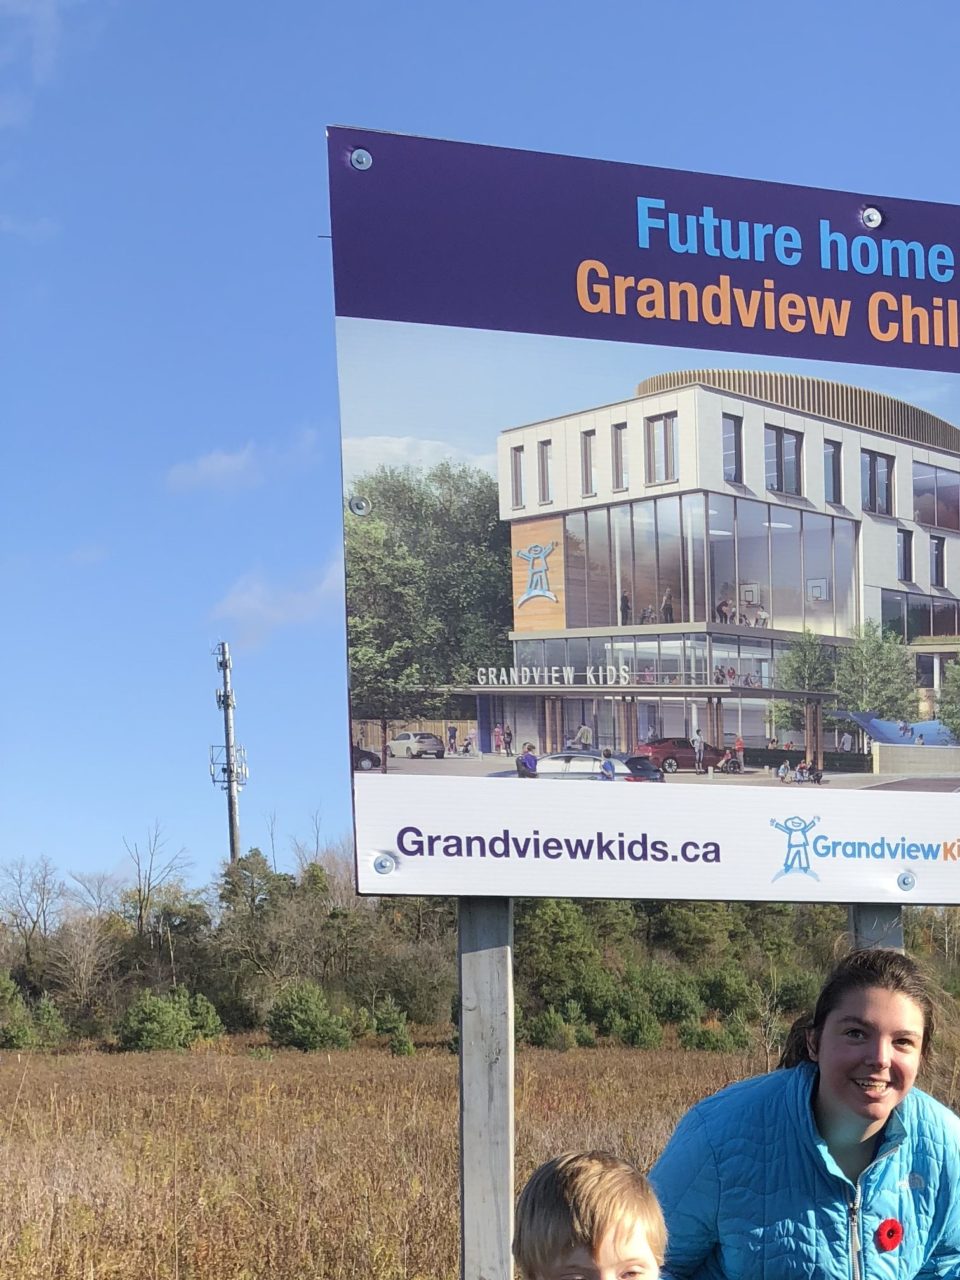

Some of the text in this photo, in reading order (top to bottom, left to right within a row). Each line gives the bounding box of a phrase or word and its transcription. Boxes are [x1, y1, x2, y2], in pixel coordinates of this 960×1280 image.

[636, 196, 802, 266] Future
[819, 219, 955, 283] home
[576, 259, 851, 337] Grandview
[477, 665, 631, 685] GRANDVIEW KIDS
[396, 826, 721, 863] Grandviewkids.ca
